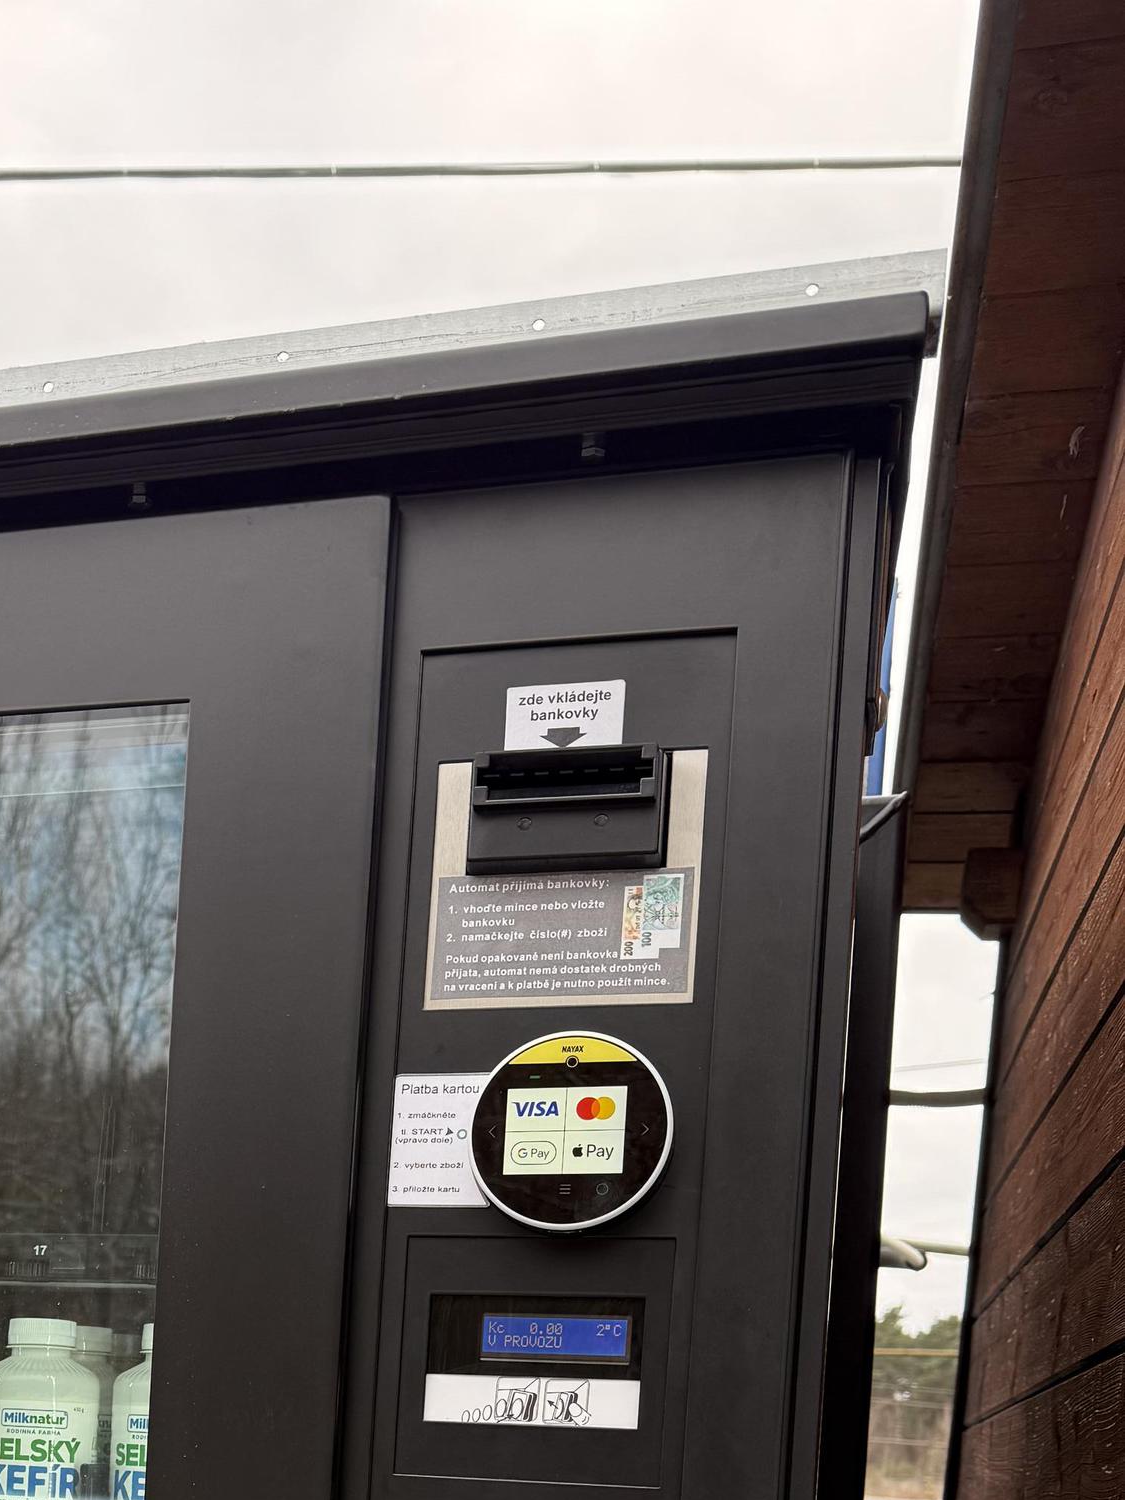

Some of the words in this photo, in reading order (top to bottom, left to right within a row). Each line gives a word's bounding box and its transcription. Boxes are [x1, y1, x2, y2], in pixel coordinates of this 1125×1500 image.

[519, 693, 543, 706] zde
[548, 690, 612, 706] vkládejte
[530, 707, 599, 721] bankovky
[449, 884, 499, 894] Automat
[502, 880, 544, 893] přijímá
[547, 878, 610, 889] bankovky:
[448, 906, 458, 914] 1.
[463, 904, 502, 913] vhoďte
[504, 903, 538, 912] mince
[540, 901, 568, 910] nebo
[571, 900, 605, 909] vložte
[462, 918, 515, 928] bankovku
[446, 934, 456, 942] 2.
[461, 931, 524, 942] namačkejte
[577, 928, 608, 938] zboží
[641, 931, 652, 947] 100
[624, 941, 634, 956] 200
[445, 954, 478, 964] Pokud
[481, 953, 538, 965] opakovaně
[541, 951, 564, 960] není
[566, 950, 618, 960] bankovka
[445, 969, 481, 979] přijata,
[483, 967, 527, 976] automat
[529, 966, 557, 975] nemá
[560, 964, 607, 974] dostatek
[609, 963, 662, 974] drobných
[508, 981, 514, 989] k
[516, 980, 549, 991] platbě
[551, 980, 561, 990] je
[564, 979, 595, 988] nutno
[597, 977, 631, 988] použít
[633, 977, 670, 986] mince.
[562, 1045, 584, 1053] NAYAX
[401, 1084, 439, 1095] Platba
[442, 1084, 480, 1094] kartou
[408, 1111, 456, 1119] zmáčkněte
[511, 1101, 559, 1117] VISA
[395, 1137, 428, 1145] (vpravo
[431, 1136, 454, 1145] dole)
[530, 1148, 550, 1161] Pay
[586, 1144, 615, 1160] Pay
[404, 1162, 437, 1170] vyberte
[437, 1185, 460, 1193] kartu
[34, 1246, 47, 1255] 17
[530, 1322, 563, 1335] 0.00
[487, 1335, 496, 1346] V
[504, 1335, 562, 1348] PROVOZU
[4, 1412, 65, 1426] Milknatur
